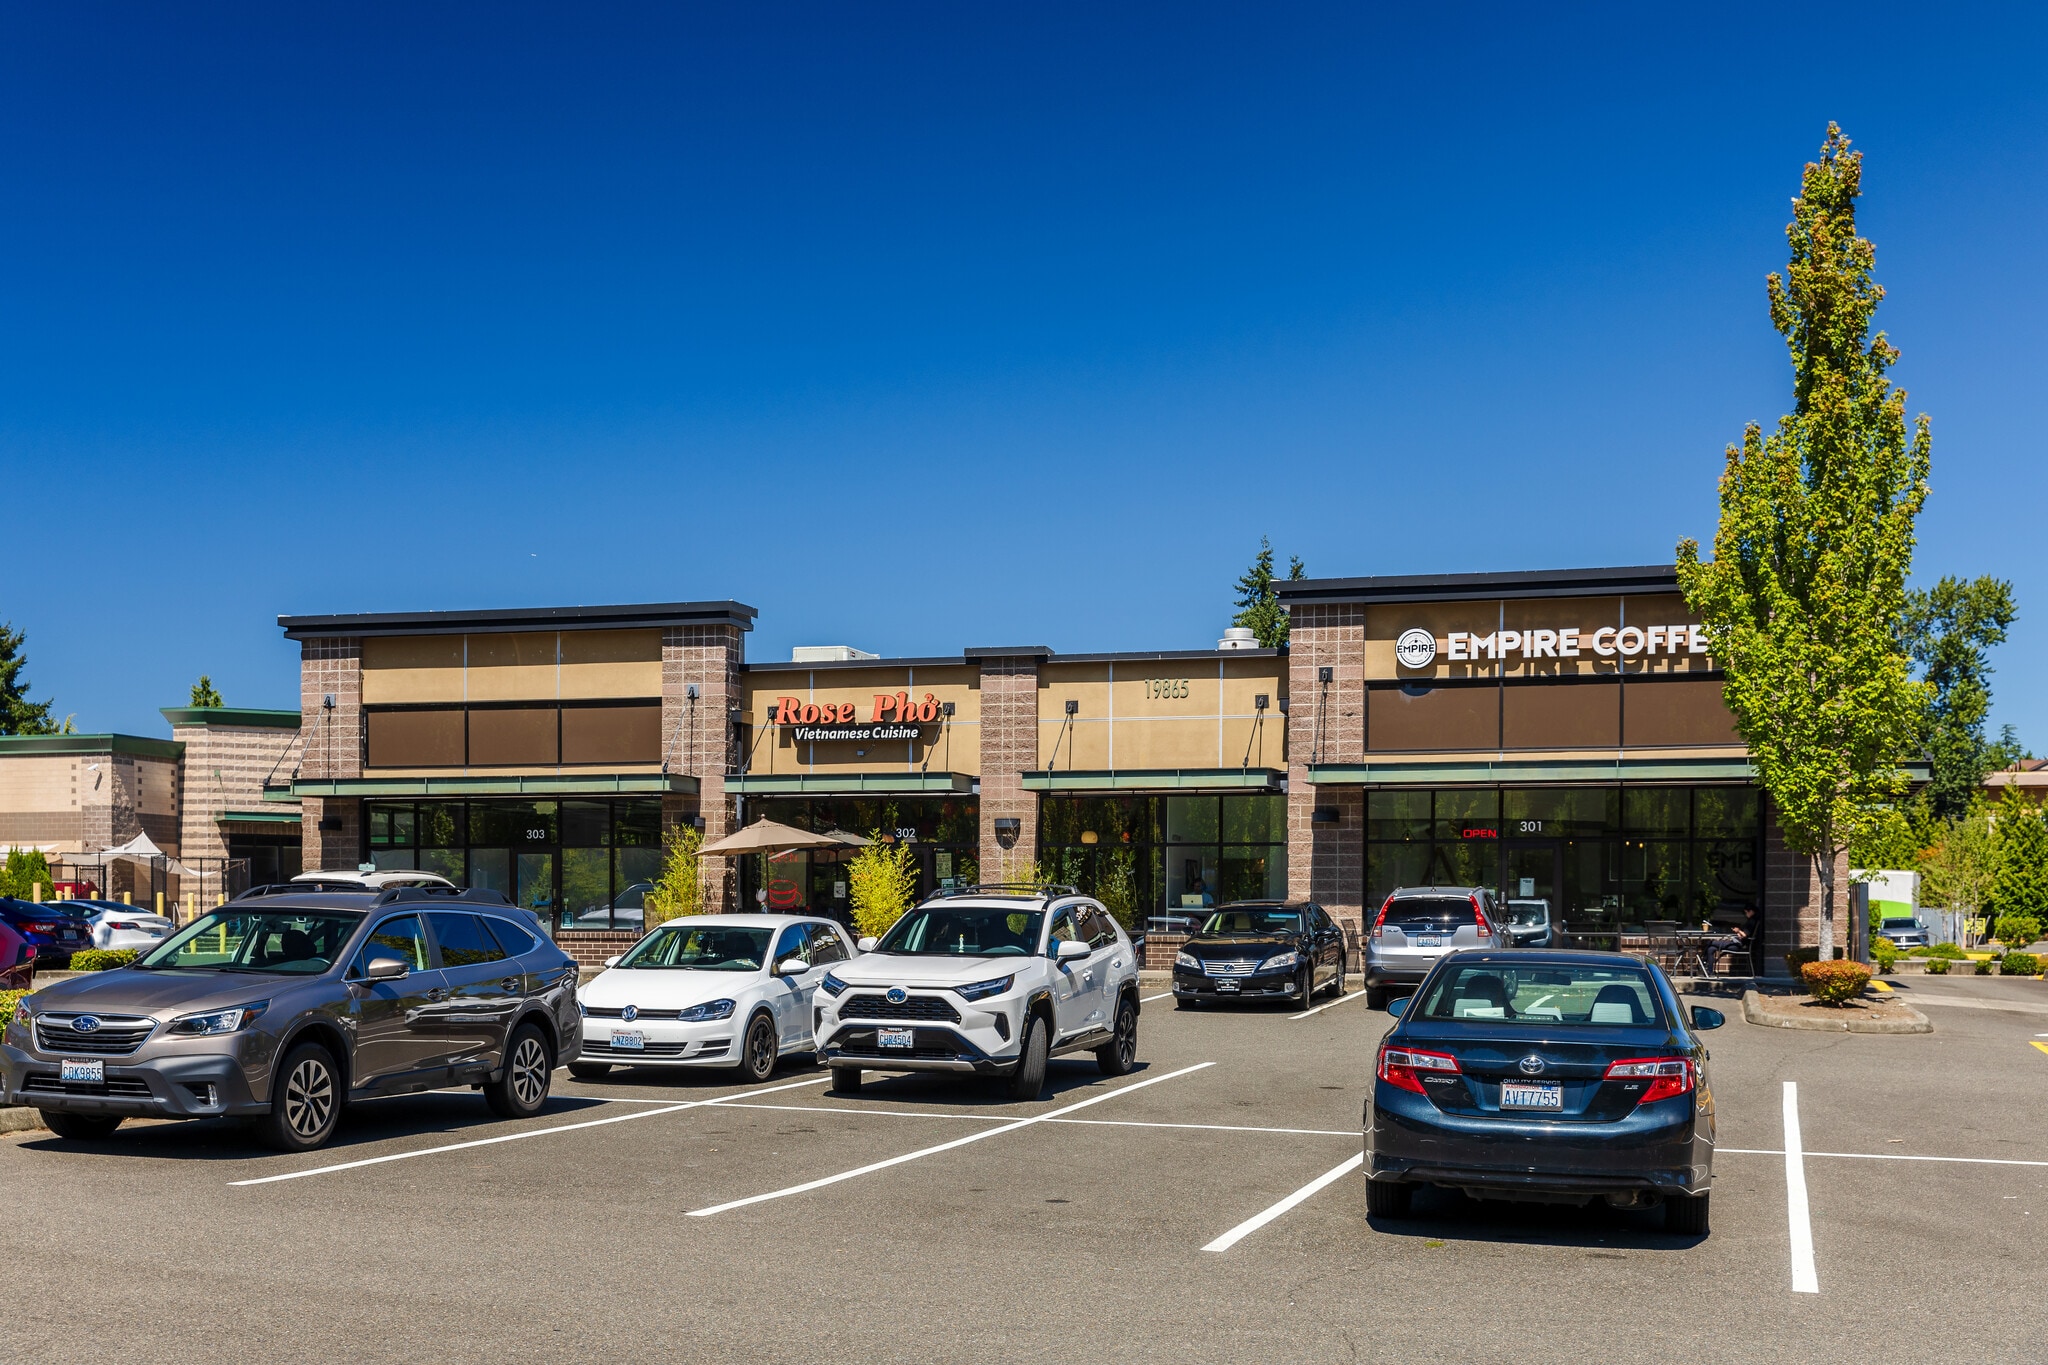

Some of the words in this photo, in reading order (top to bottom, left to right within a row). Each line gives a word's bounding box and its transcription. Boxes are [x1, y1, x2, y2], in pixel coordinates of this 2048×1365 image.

[1397, 643, 1434, 654] EMPIRE
[1448, 628, 1580, 660] EMPIRE
[1592, 624, 1732, 655] COFFE
[1144, 678, 1189, 699] 19865
[776, 696, 855, 724] Rose
[795, 727, 870, 740] Vietnamese
[872, 725, 919, 739] Cuisine
[895, 827, 916, 838] 302
[1463, 829, 1497, 838] OPEN
[1520, 821, 1542, 832] 301
[526, 829, 545, 839] 303
[63, 1066, 102, 1080] CDK9855
[1504, 1090, 1558, 1106] AVT7755
